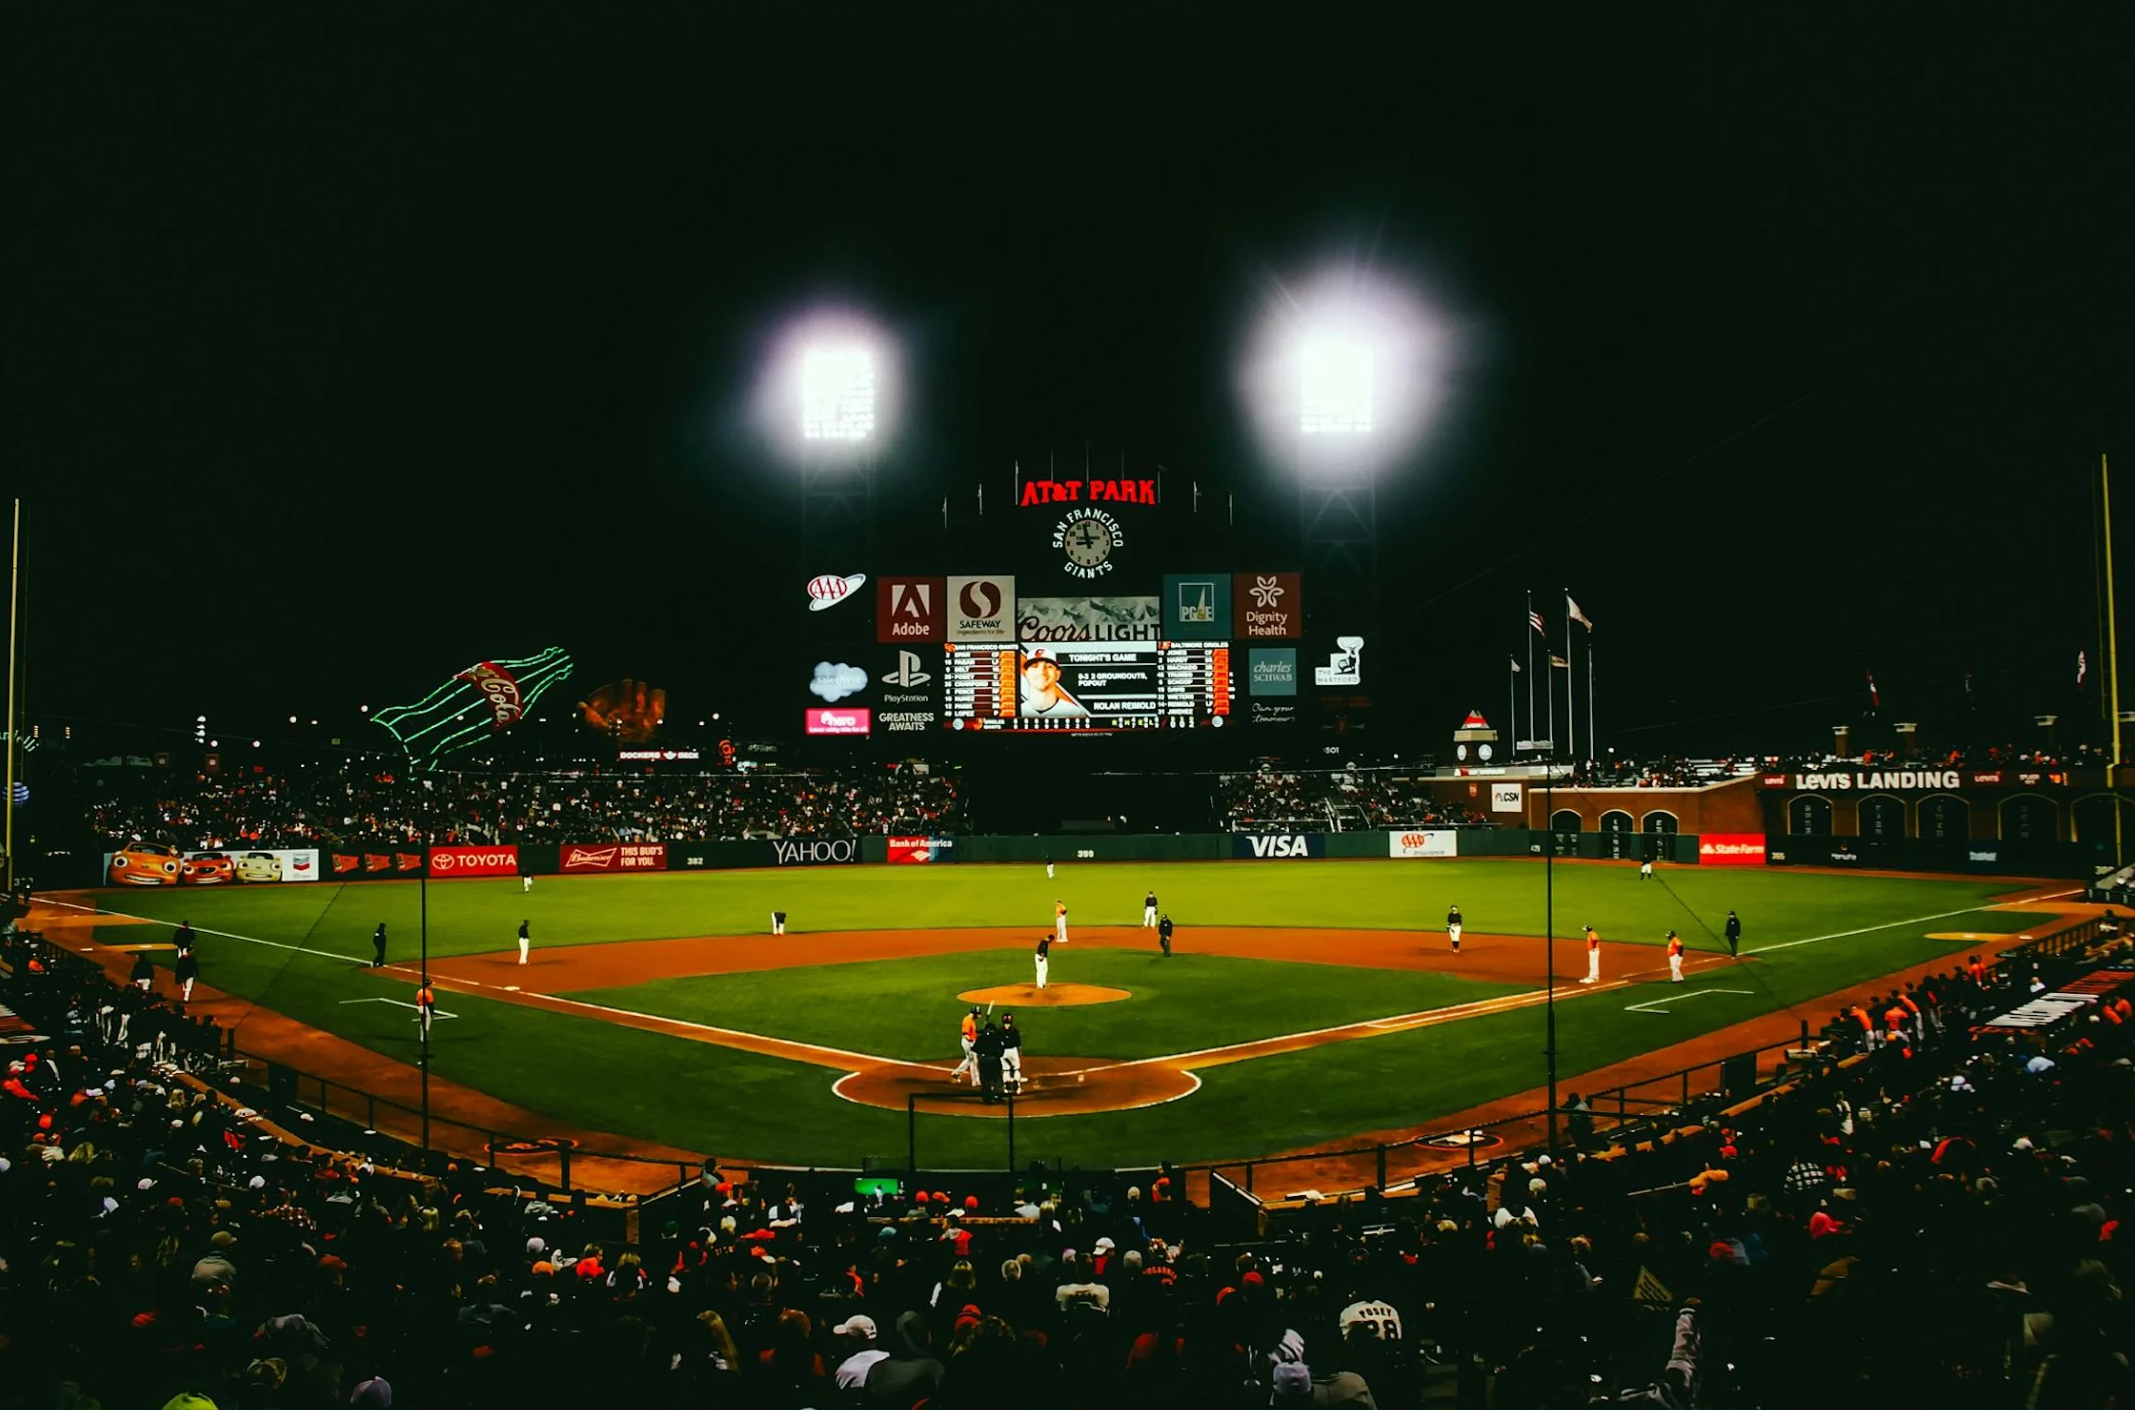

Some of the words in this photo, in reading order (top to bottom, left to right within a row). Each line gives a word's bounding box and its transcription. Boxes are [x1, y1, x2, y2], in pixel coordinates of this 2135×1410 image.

[1020, 480, 1082, 506] AT&T
[1090, 479, 1156, 505] PARK
[1052, 521, 1068, 548] SAN
[1066, 507, 1124, 547] FRANCISCO
[1064, 560, 1113, 578] GIANTS
[811, 578, 847, 600] AAA
[1182, 606, 1212, 620] PG&E
[1246, 611, 1288, 624] Dignity
[892, 622, 930, 636] Adobe
[960, 620, 1001, 629] SAFEWAY
[1018, 616, 1092, 641] Coors
[1095, 624, 1160, 641] LIGHT
[1249, 625, 1286, 636] Health
[1069, 654, 1111, 662] TONIGHT'S
[1254, 661, 1292, 672] charles
[481, 678, 520, 724] Cola
[884, 694, 928, 704] PlayStation
[1094, 702, 1120, 710] NOLAN
[879, 712, 934, 722] GREATNESS
[888, 722, 925, 731] AWAITS
[1857, 772, 1960, 789] LANDING
[1504, 792, 1519, 802] CSN
[890, 839, 910, 848] Bank
[910, 839, 919, 847] of
[919, 839, 952, 848] America
[1245, 835, 1309, 857] VISA
[1716, 844, 1740, 854] State
[1740, 846, 1764, 854] Farm
[620, 847, 638, 856] THIS
[640, 846, 663, 856] BUD'S
[773, 840, 856, 864] YAHOO!
[457, 854, 517, 867] TOYOTA
[620, 858, 636, 866] FOR
[637, 857, 655, 866] YOU.
[1359, 1308, 1392, 1318] POSEY
